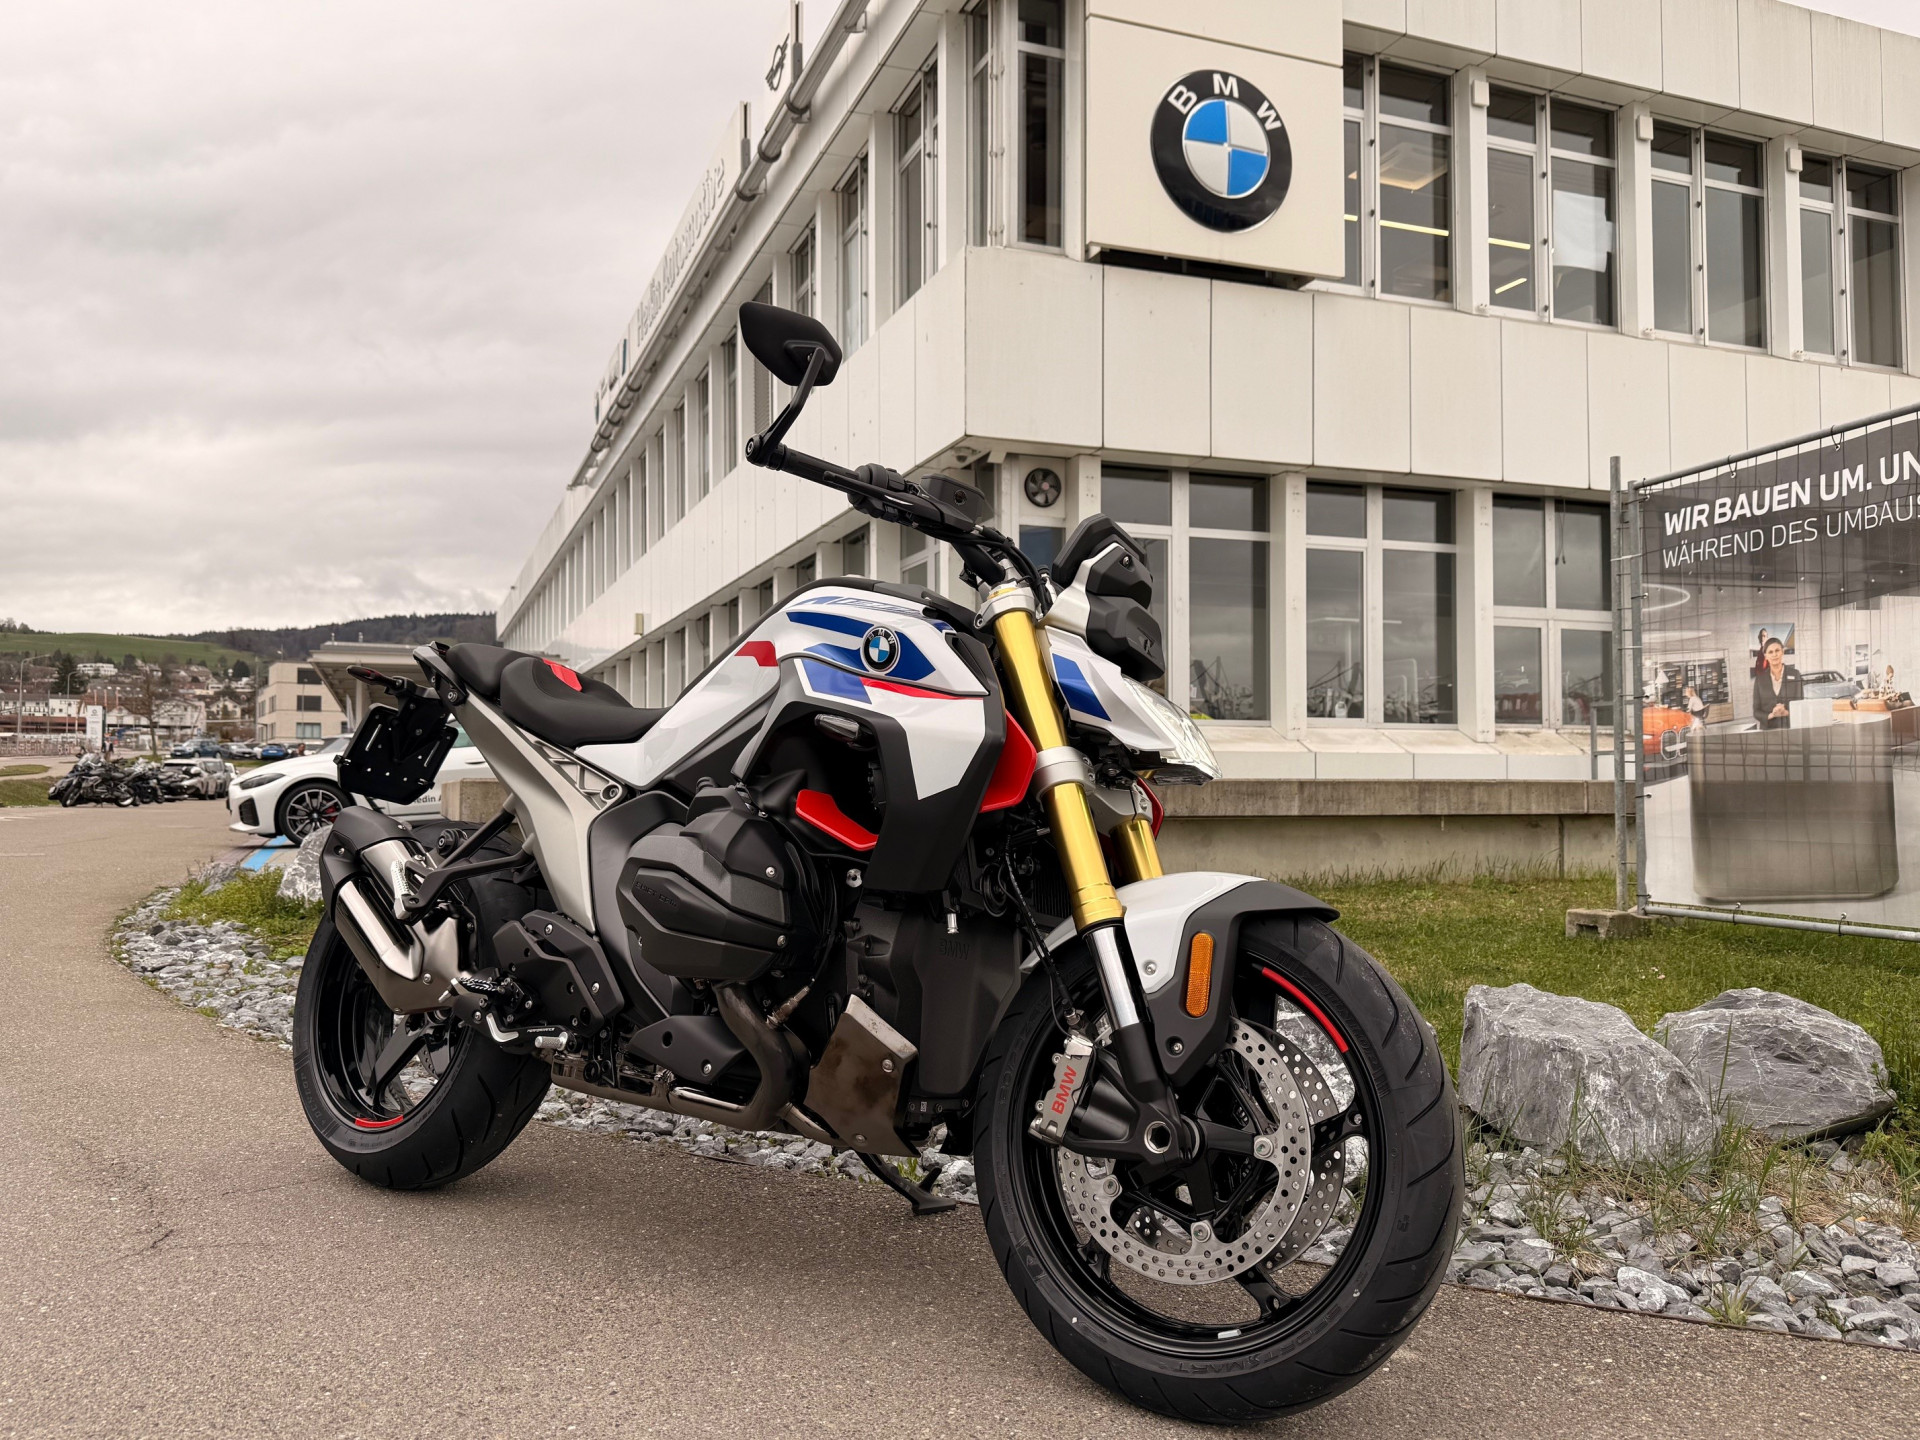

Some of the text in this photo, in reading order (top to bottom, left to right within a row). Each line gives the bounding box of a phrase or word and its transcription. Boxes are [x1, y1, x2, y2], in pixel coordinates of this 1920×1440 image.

[1167, 73, 1282, 131] BMW
[1664, 503, 1710, 536] WIR
[1713, 478, 1811, 525] BAUEN
[1819, 463, 1873, 501] UM.
[1662, 495, 1920, 568] WÄHREND DES UMBAU
[866, 628, 895, 645] BMW
[414, 794, 436, 803] edin
[938, 938, 970, 960] BMW
[1052, 1065, 1077, 1115] BMW
